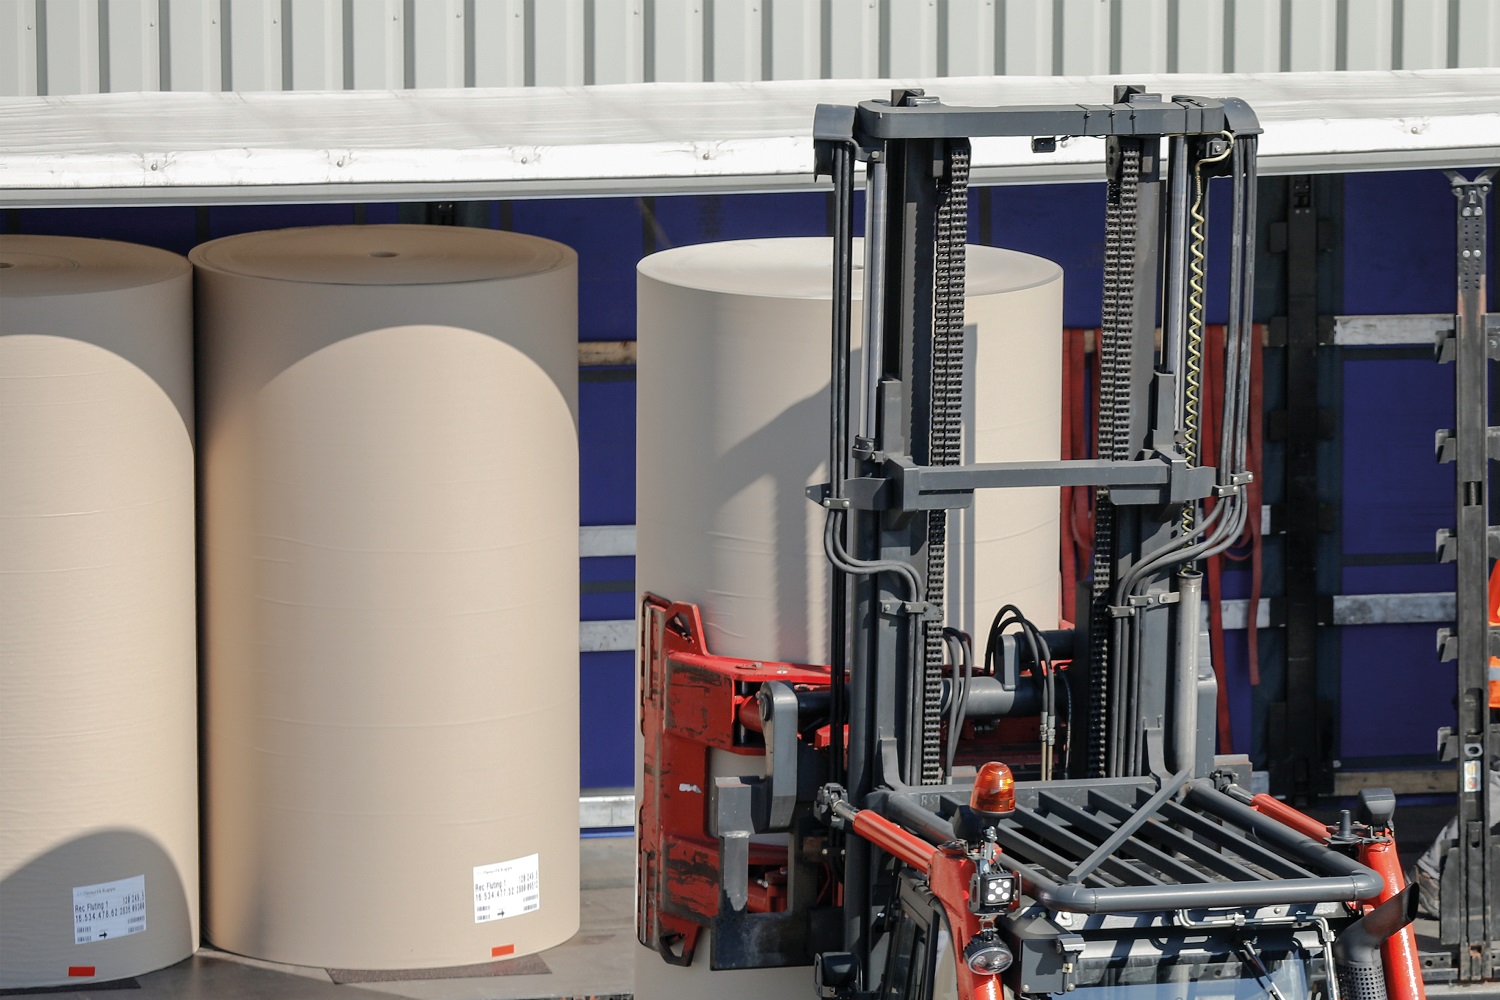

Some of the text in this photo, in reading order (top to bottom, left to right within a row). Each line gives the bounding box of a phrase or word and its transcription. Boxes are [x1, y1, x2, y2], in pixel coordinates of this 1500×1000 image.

[475, 883, 484, 892] Rec
[486, 880, 502, 890] Fluting
[75, 904, 85, 912] Rec
[87, 902, 104, 912] Fluting
